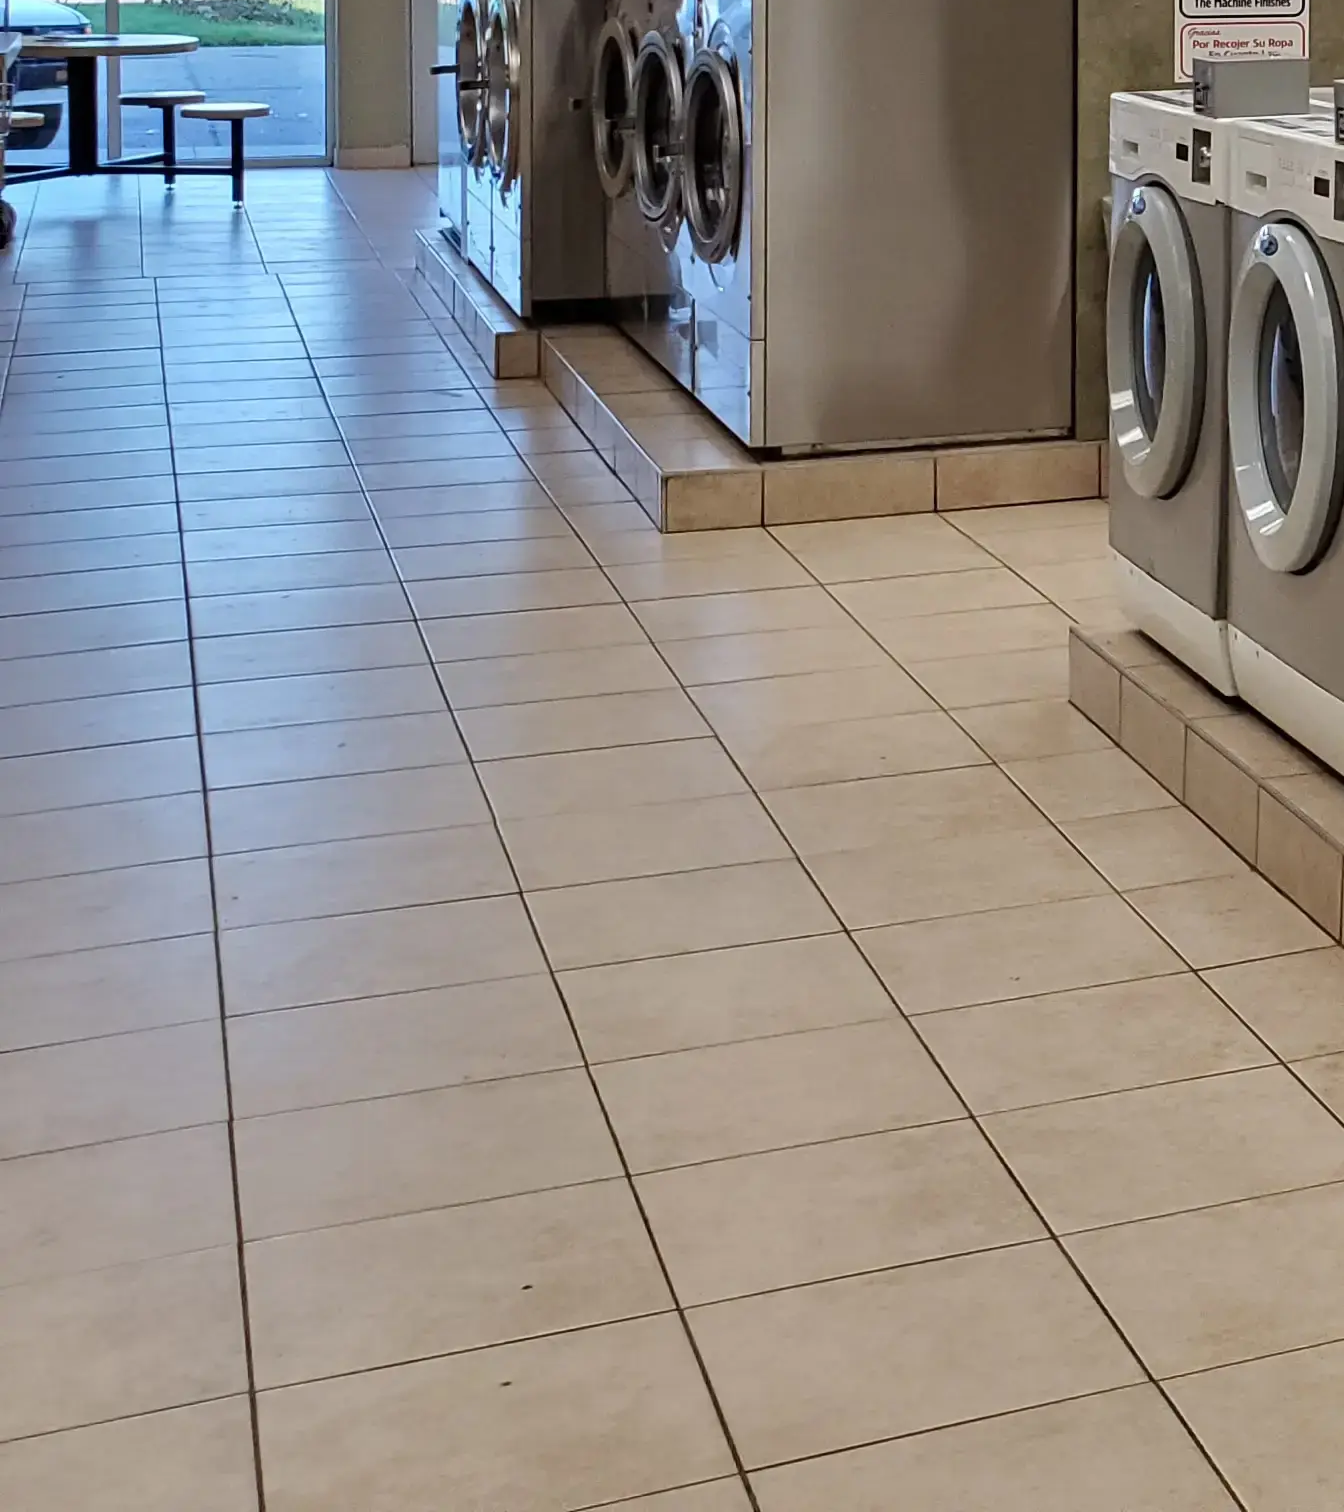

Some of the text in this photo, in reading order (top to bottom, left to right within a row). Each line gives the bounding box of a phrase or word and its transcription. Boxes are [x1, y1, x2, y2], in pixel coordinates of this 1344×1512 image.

[1192, 38, 1294, 50] Por Recojer Su Ropa
